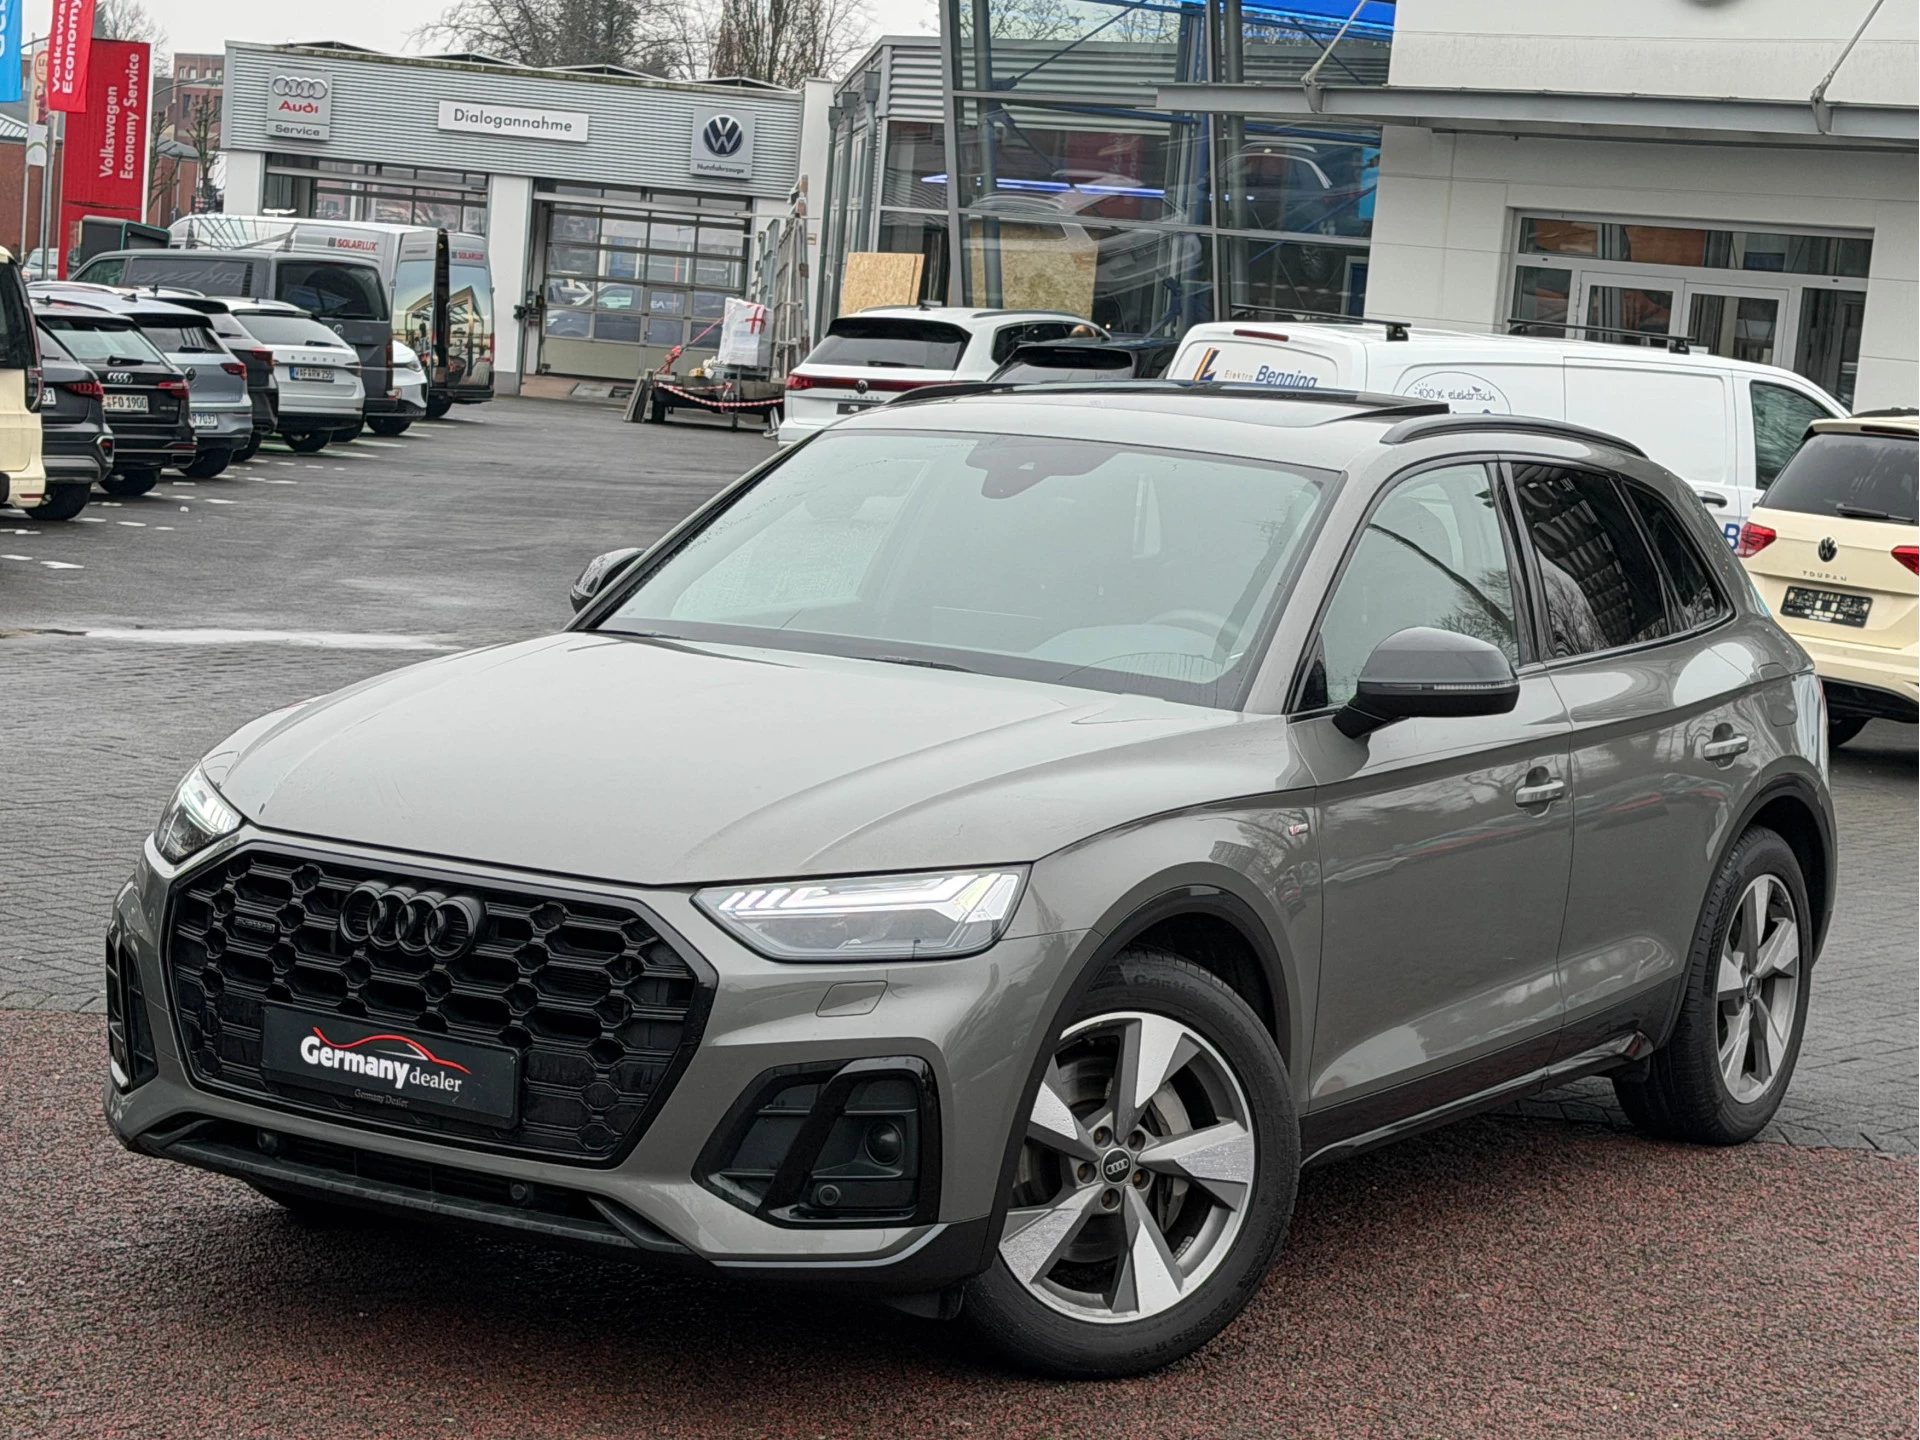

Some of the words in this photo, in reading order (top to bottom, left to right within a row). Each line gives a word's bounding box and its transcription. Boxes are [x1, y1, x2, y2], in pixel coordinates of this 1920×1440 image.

[123, 53, 140, 108] Service
[278, 100, 319, 114] Audi
[99, 86, 120, 177] Volkswagen
[275, 124, 320, 137] Service
[453, 108, 573, 132] Dialogannahme
[119, 111, 139, 180] Economy
[337, 238, 379, 252] SOLARLUX
[1255, 364, 1318, 388] Benning
[1448, 389, 1496, 402] elektrisch
[300, 1035, 410, 1090] Germany
[409, 1066, 463, 1093] dealer
